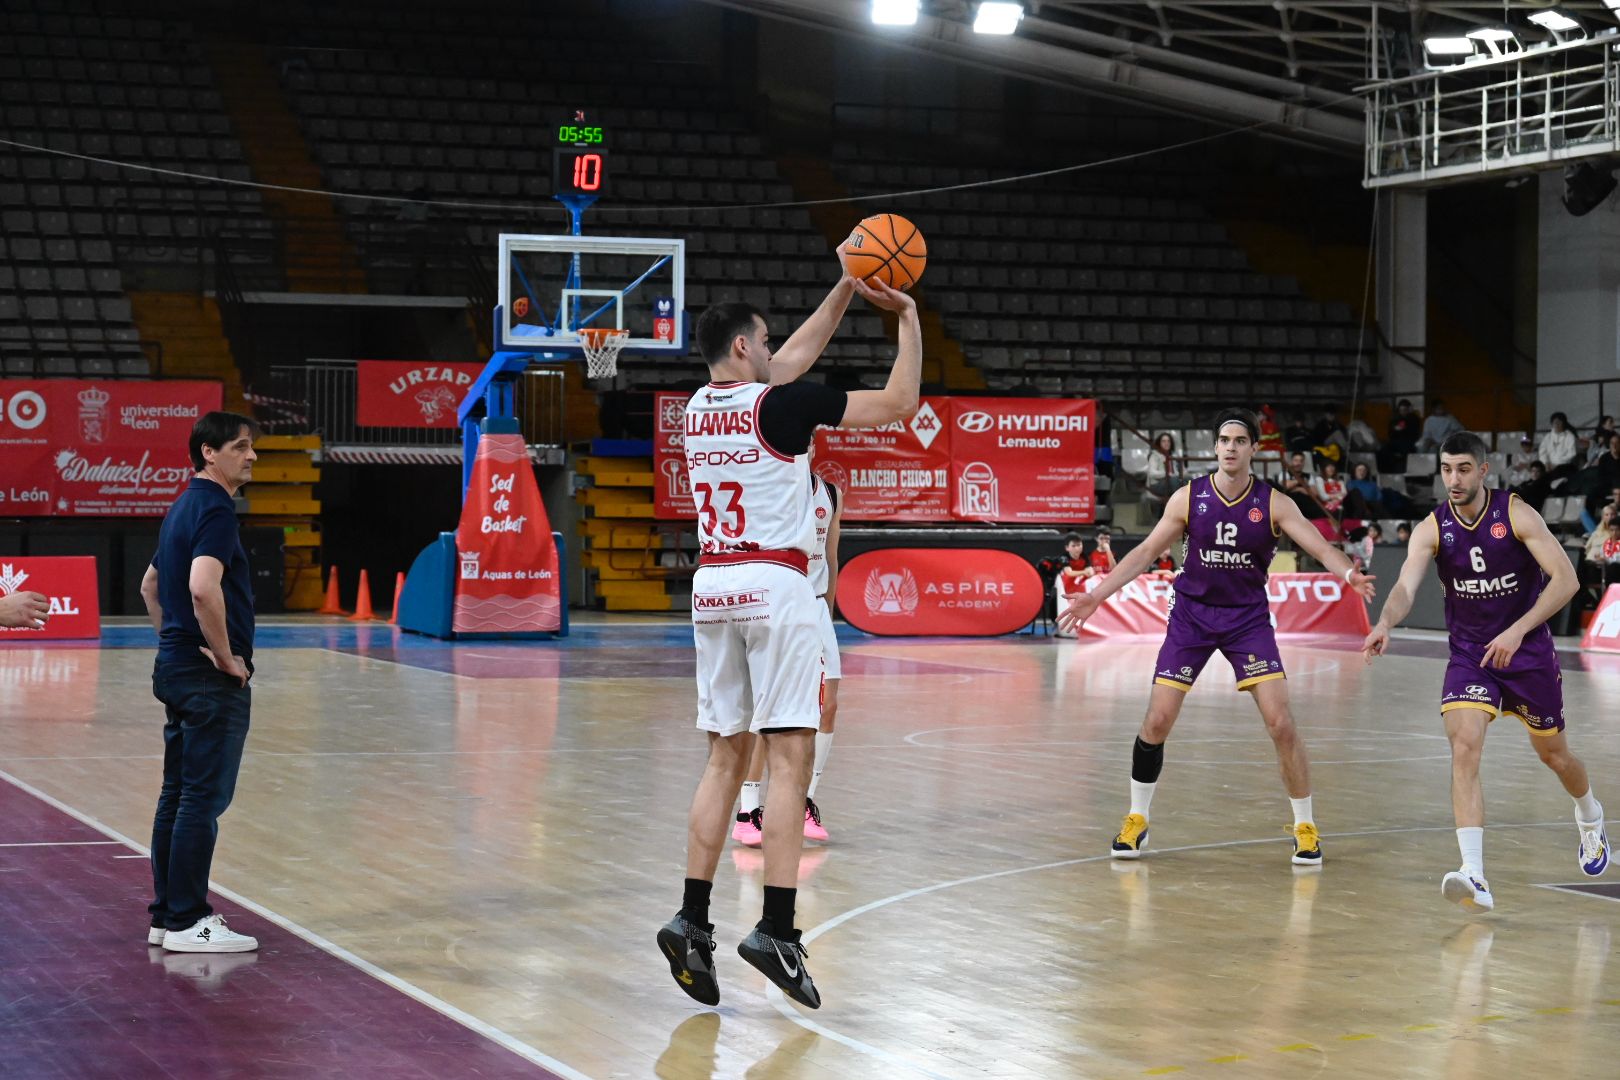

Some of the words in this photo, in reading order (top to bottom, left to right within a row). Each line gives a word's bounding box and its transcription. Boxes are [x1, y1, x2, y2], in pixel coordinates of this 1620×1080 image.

[559, 126, 602, 142] 05:55
[573, 154, 601, 190] 10
[389, 367, 474, 395] URZAP
[120, 404, 198, 417] universidad
[132, 415, 159, 429] león
[686, 411, 752, 437] LLAMAS
[998, 415, 1088, 431] HYUNDAI
[998, 436, 1060, 448] Lemauto
[489, 473, 515, 493] Sed
[850, 469, 897, 488] RANCHO
[900, 469, 932, 488] CHICO
[935, 469, 947, 488] III
[11, 486, 49, 502] León
[967, 484, 991, 512] R3
[493, 494, 509, 513] de
[695, 481, 746, 538] 33
[481, 515, 527, 533] Basket
[1215, 521, 1238, 546] 12
[1199, 549, 1252, 565] UEMC
[1469, 546, 1487, 573] 6
[482, 570, 512, 580] Aguas
[514, 570, 526, 579] de
[528, 570, 551, 579] León
[1453, 572, 1518, 594] UEMC
[925, 583, 1014, 596] ASPIRE
[938, 600, 1001, 608] ACADEMY
